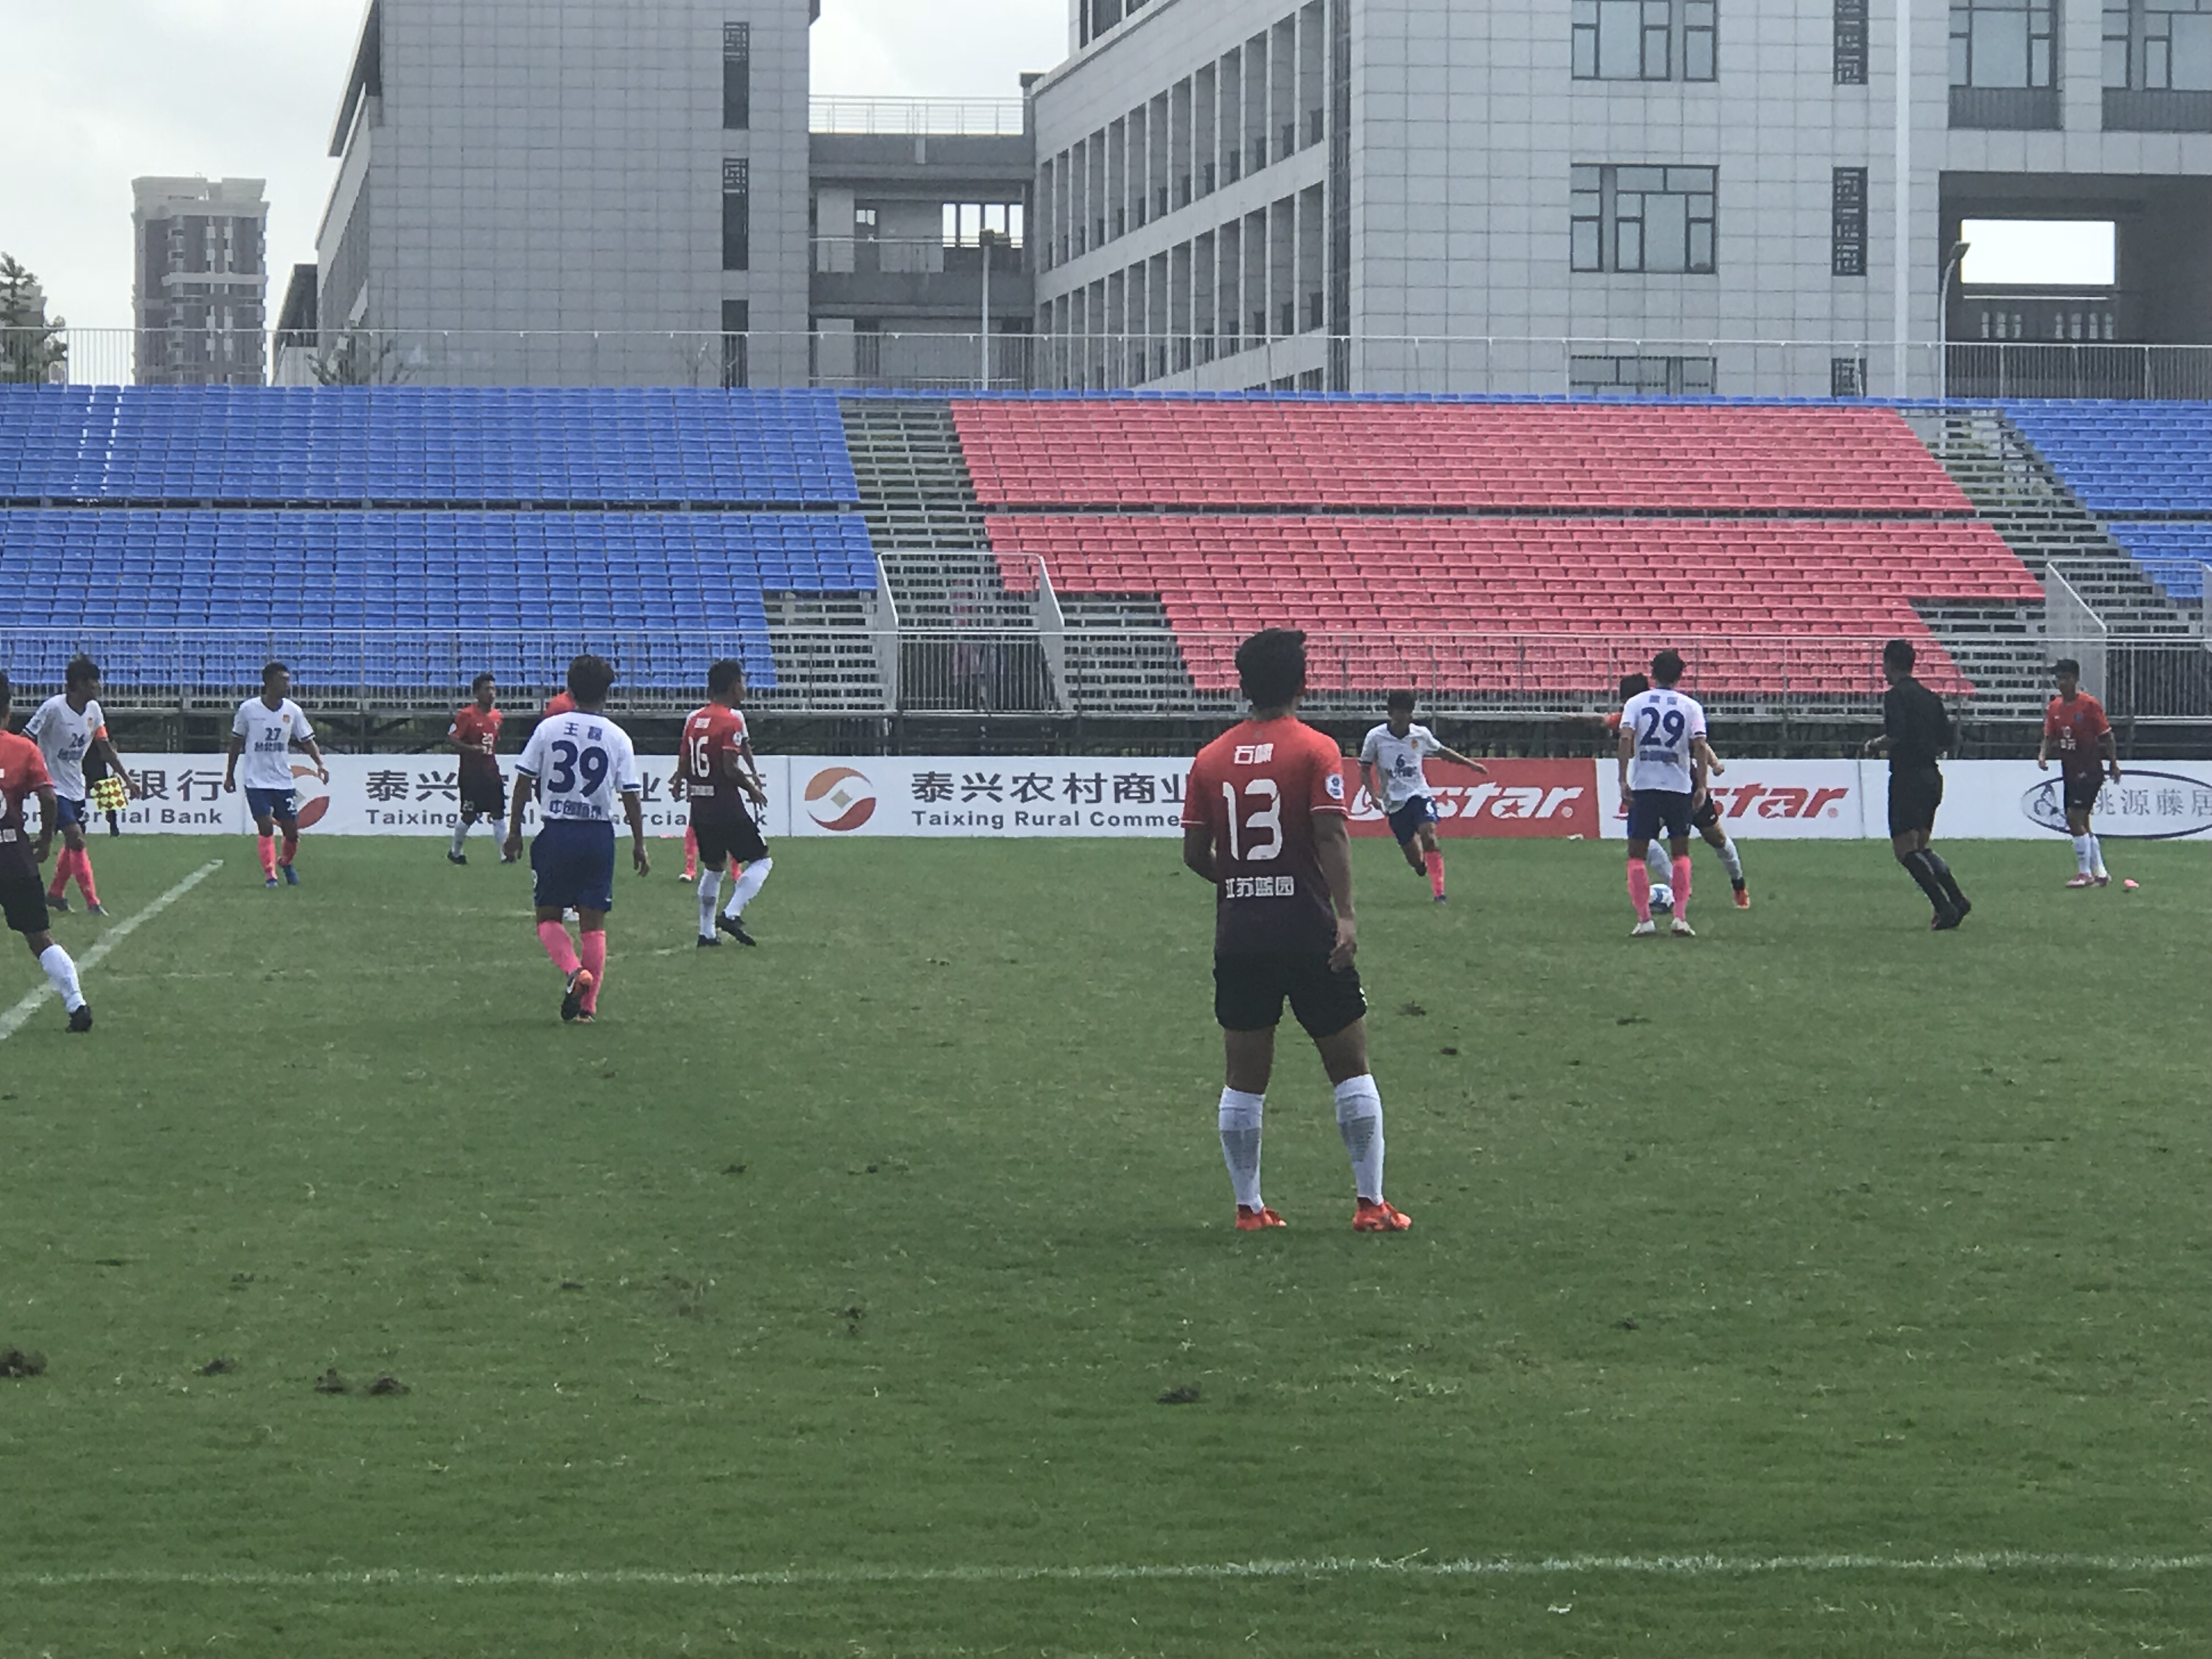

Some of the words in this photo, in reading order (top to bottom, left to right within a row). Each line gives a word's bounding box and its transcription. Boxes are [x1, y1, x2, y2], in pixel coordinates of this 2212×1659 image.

[265, 727, 282, 741] 27
[1639, 707, 1685, 749] 29
[689, 736, 710, 777] 16
[1395, 754, 1405, 768] 6
[548, 740, 608, 798] 39
[161, 808, 223, 824] Bank
[365, 809, 458, 828] Taixing
[911, 810, 1005, 830] Taixing
[1015, 810, 1080, 827] Rural
[1223, 779, 1283, 860] 13
